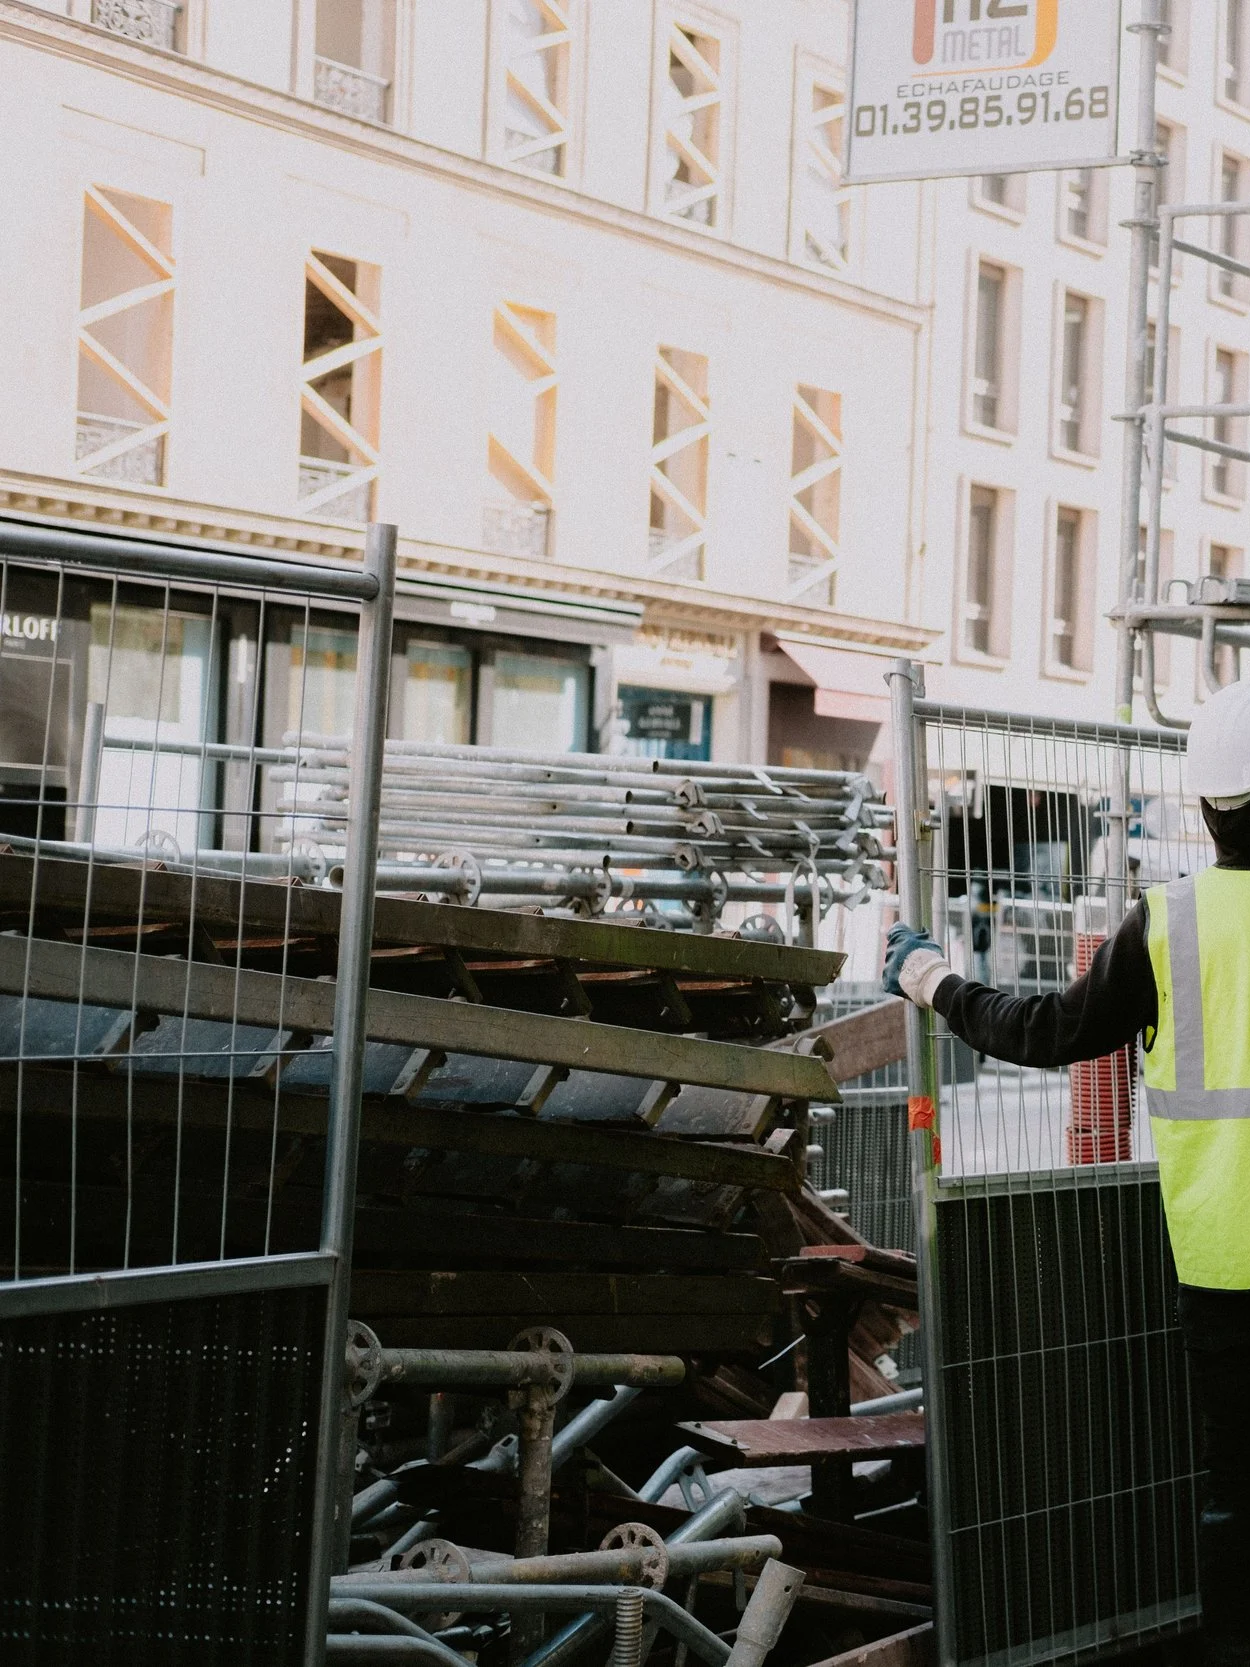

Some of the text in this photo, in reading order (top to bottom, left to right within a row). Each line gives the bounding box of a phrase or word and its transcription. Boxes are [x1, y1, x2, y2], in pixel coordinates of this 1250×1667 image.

[941, 24, 1027, 63] METAL
[896, 70, 1070, 99] ECHAFAUDAGE
[854, 85, 1109, 138] 01.39.85.91.68
